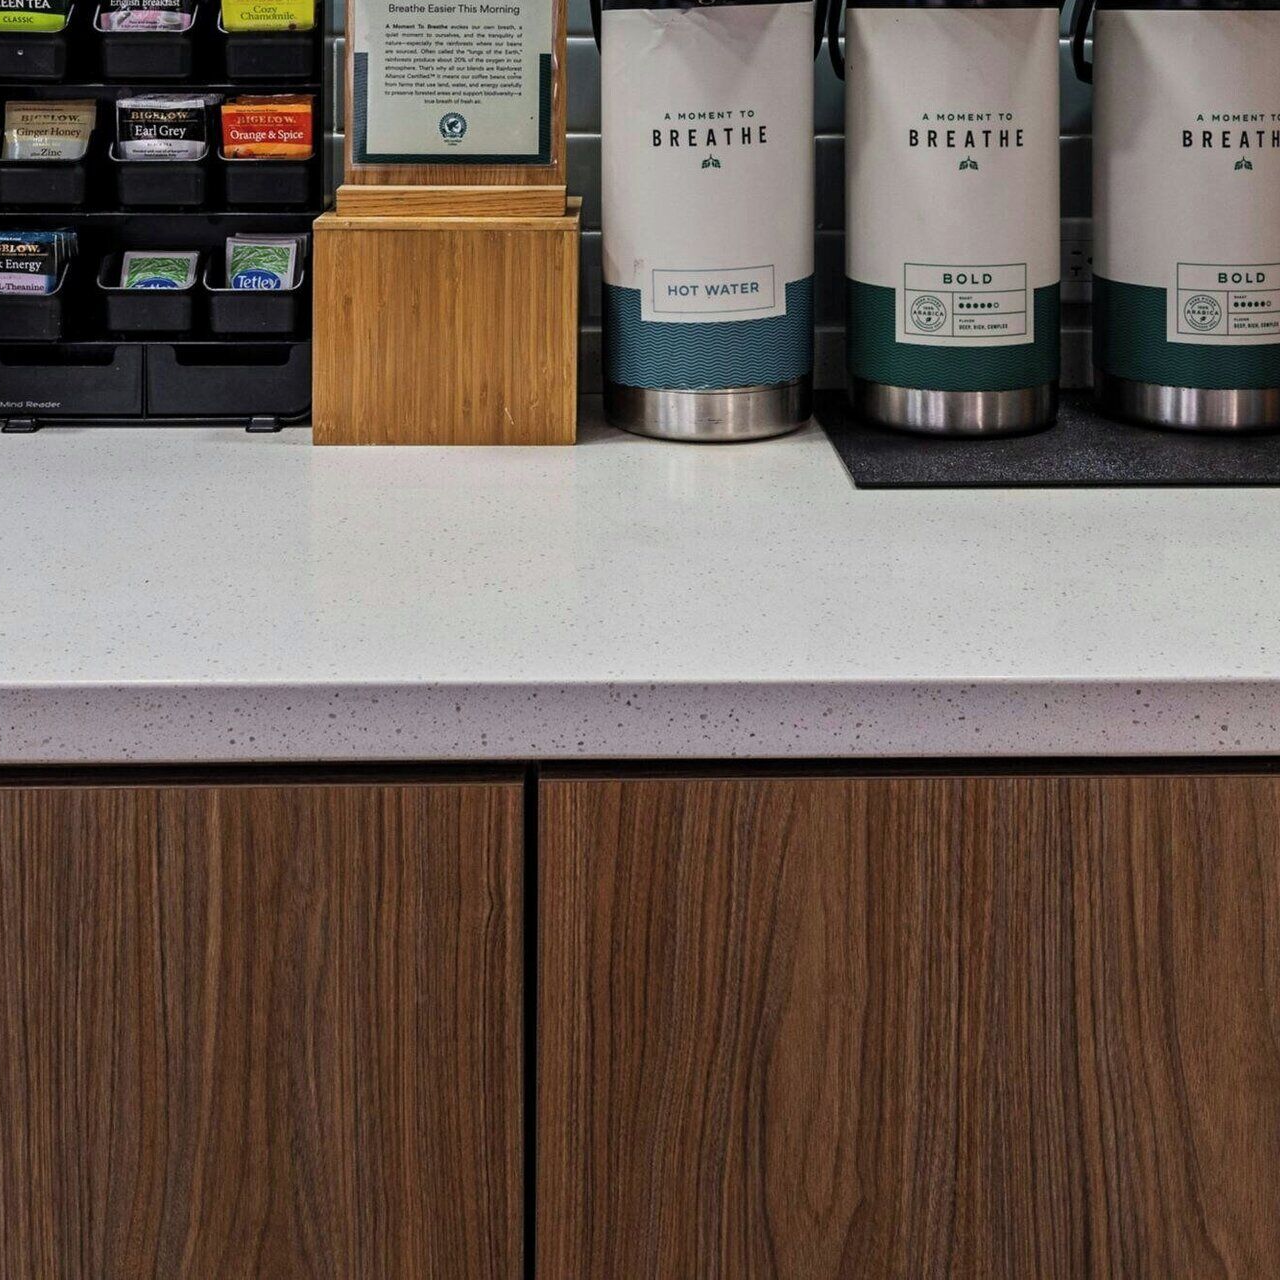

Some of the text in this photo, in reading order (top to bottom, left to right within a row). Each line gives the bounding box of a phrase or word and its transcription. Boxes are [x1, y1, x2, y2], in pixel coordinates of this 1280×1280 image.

[24, 0, 51, 9] TEA
[253, 6, 277, 14] Cozy
[389, 4, 520, 15] Breathe Easier This Morning
[240, 12, 295, 20] Chamomile
[678, 111, 733, 120] MOMENT
[740, 110, 755, 118] TO
[937, 113, 992, 121] MOMENT
[17, 128, 81, 138] Ginger Honey
[135, 125, 187, 139] Earl Grey
[230, 130, 303, 141] Orange & Spice
[652, 126, 767, 147] BREATHE
[909, 129, 1024, 148] BREATHE
[41, 148, 62, 156] Zinc
[6, 259, 41, 271] Energy
[238, 275, 278, 289] Tetley
[943, 273, 992, 284] BOLD
[1218, 273, 1265, 283] BOLD
[668, 282, 759, 296] HOT WATER
